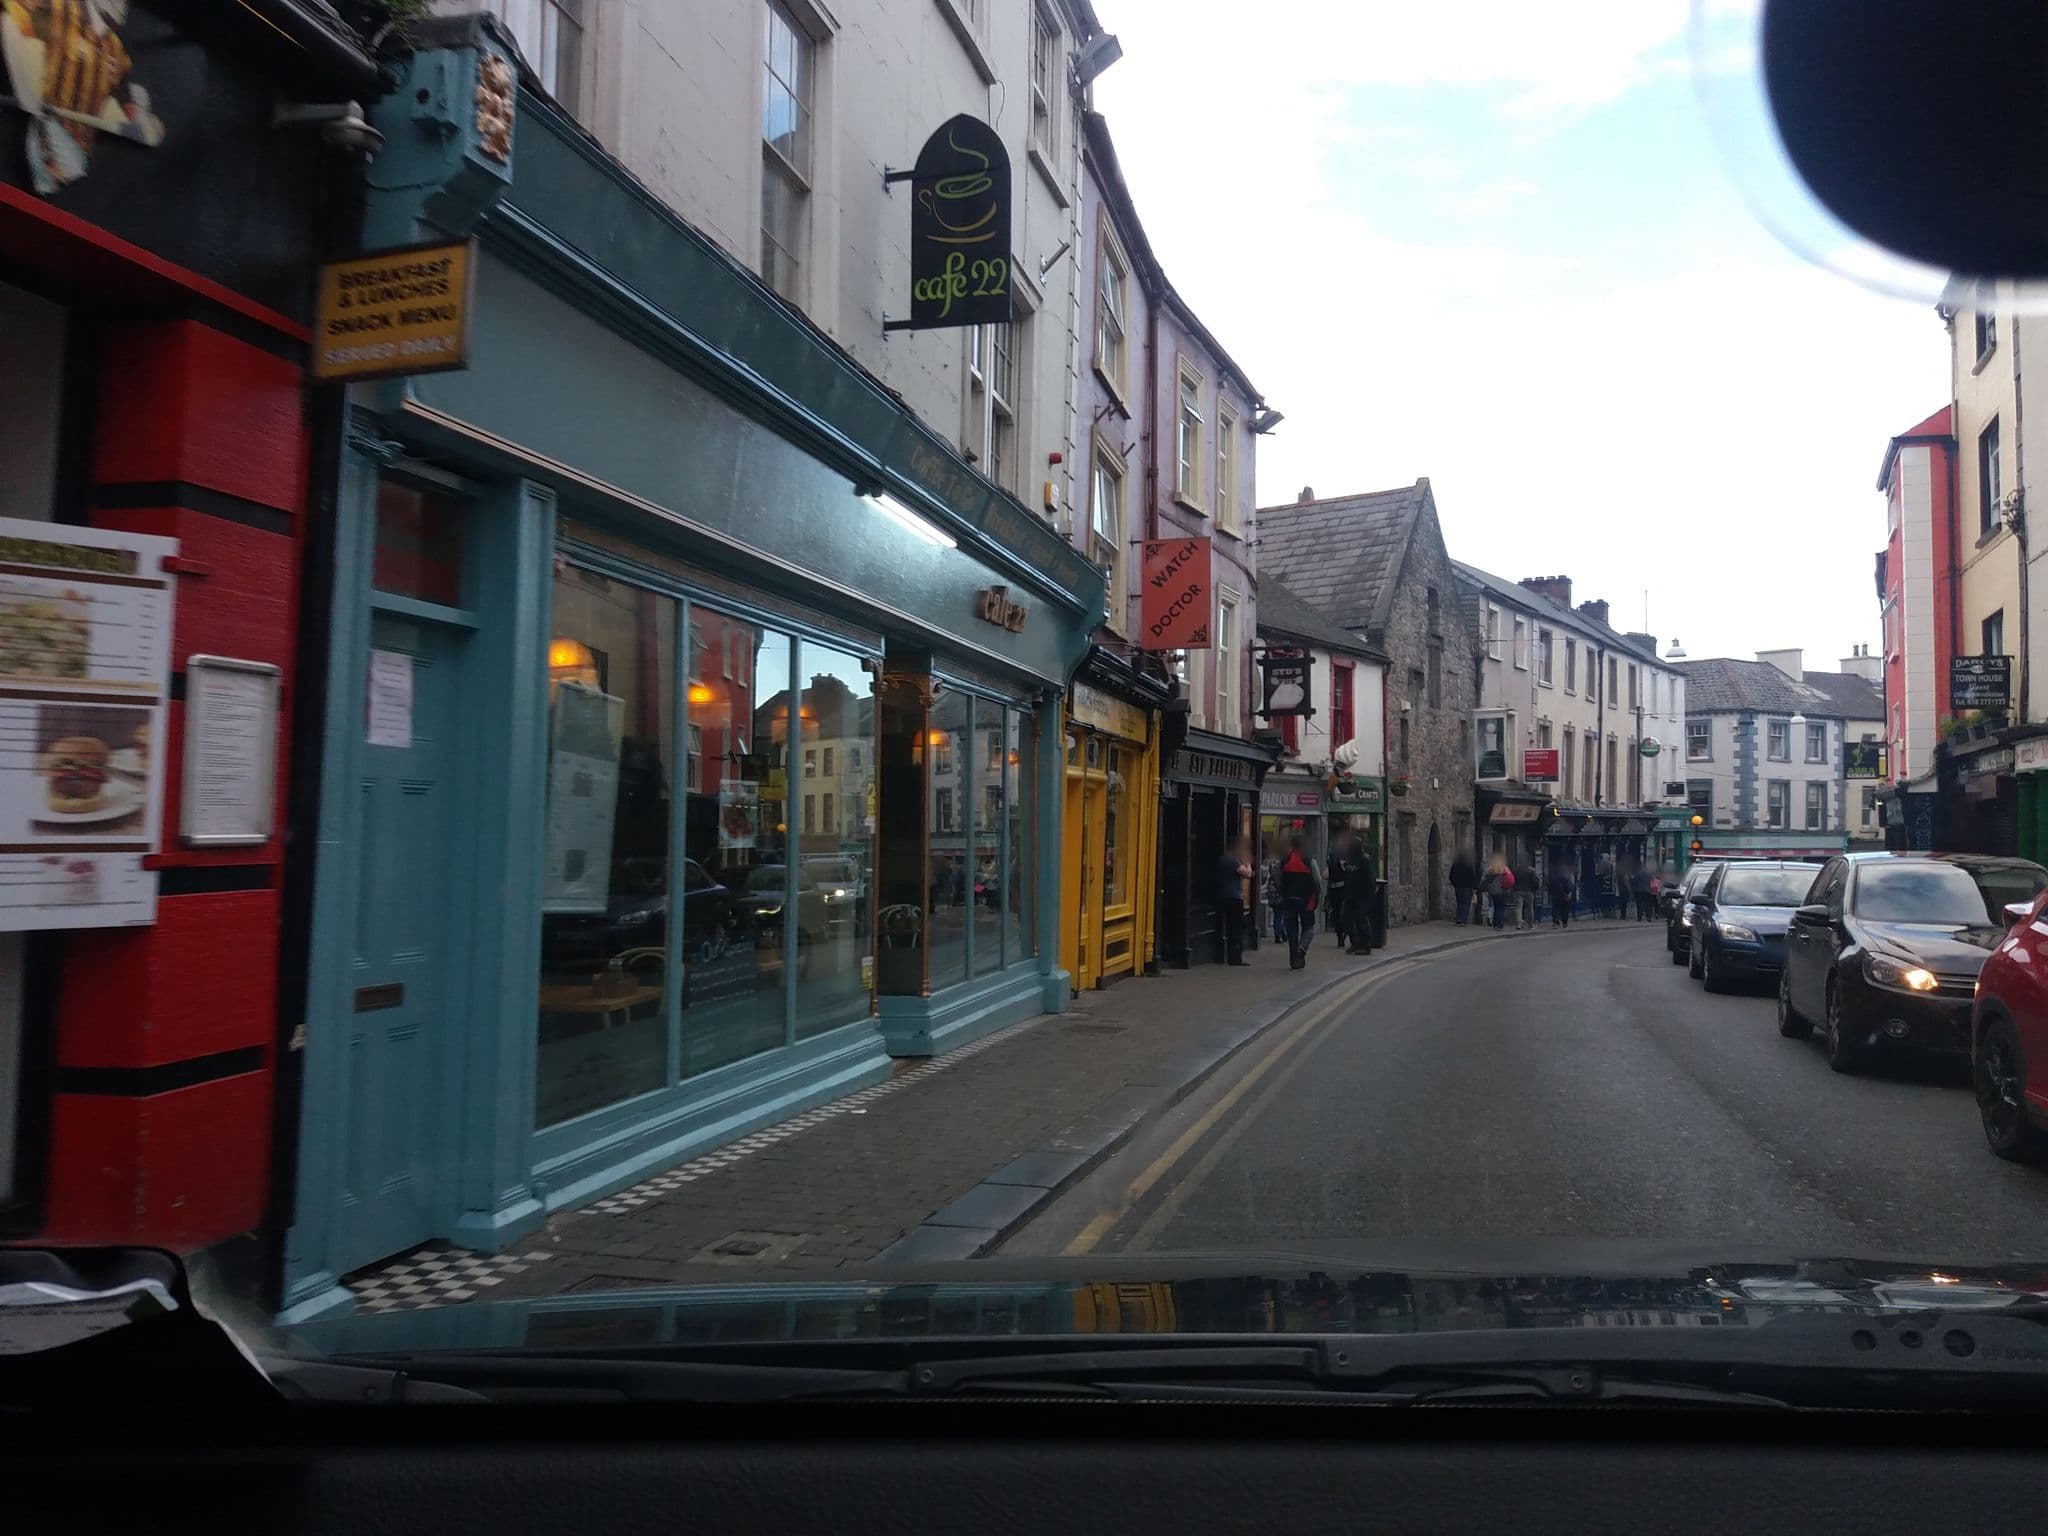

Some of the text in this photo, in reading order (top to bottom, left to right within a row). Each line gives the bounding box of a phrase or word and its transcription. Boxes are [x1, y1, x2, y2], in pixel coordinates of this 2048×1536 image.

[337, 256, 453, 289] BREAKFAST
[970, 257, 1007, 296] 22
[338, 279, 449, 308] & LUNCHES
[327, 304, 458, 335] SNACK MENU
[1150, 541, 1199, 588] WATCH
[1150, 583, 1202, 638] DOCTOR
[1955, 674, 2004, 682] TOWN HOUSE
[1261, 791, 1298, 809] PARLOUR
[1358, 789, 1379, 800] CRAFTS
